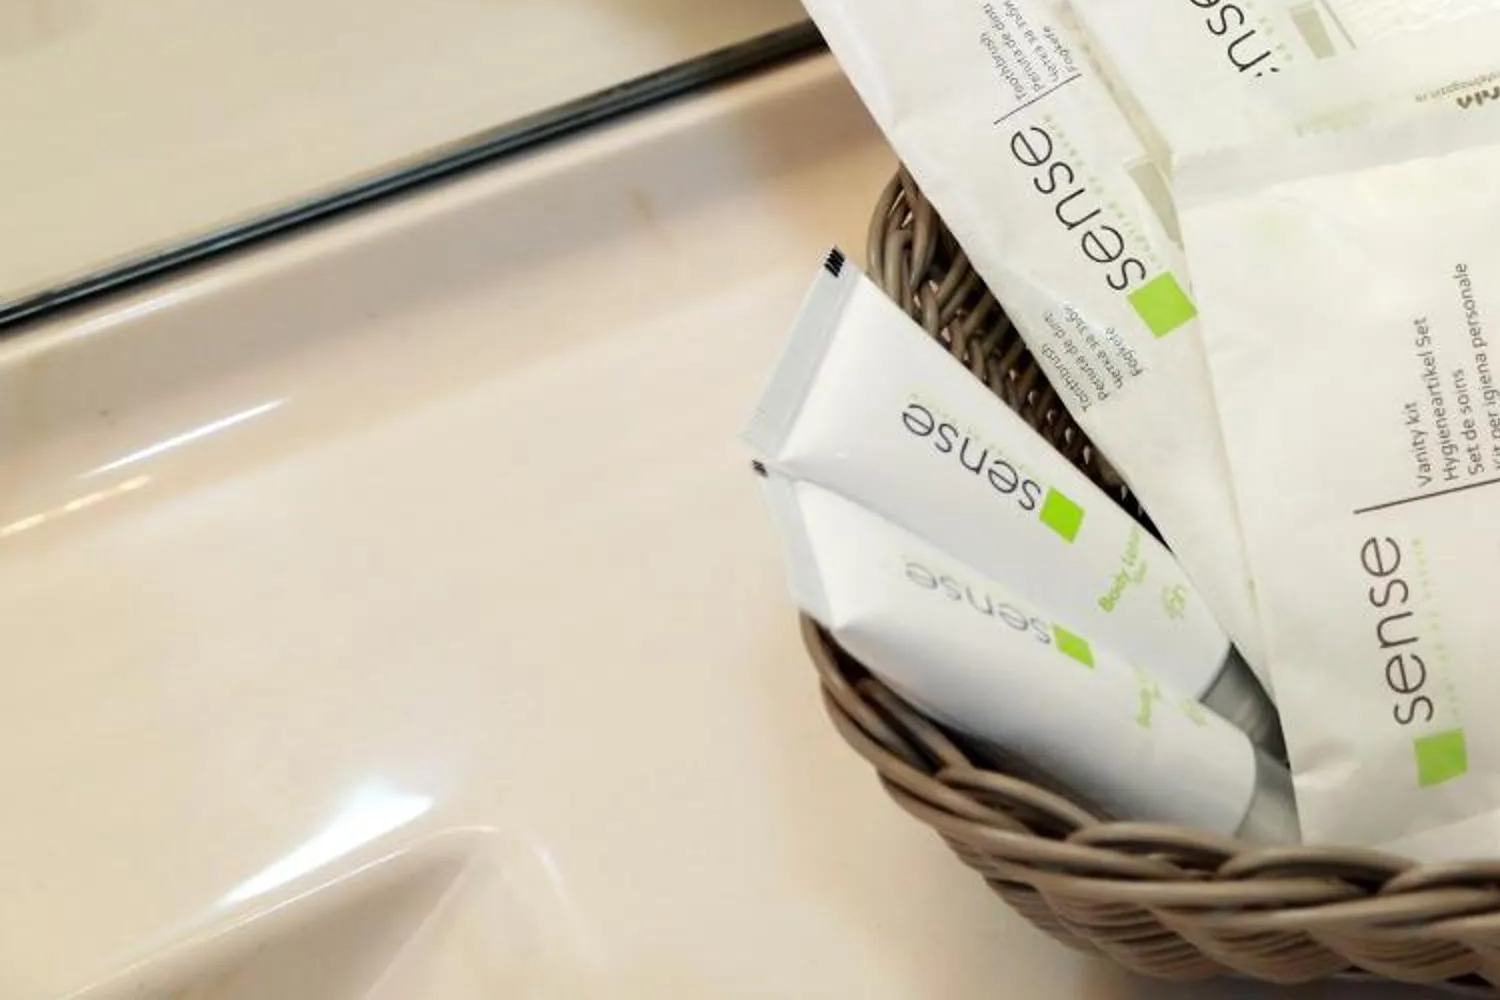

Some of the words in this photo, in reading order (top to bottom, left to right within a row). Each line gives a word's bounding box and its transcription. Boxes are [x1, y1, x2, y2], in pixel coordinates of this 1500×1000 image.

[980, 32, 1028, 101] Toothbrush
[1002, 32, 1017, 48] de
[1011, 127, 1146, 290] sense
[1414, 317, 1431, 347] Set
[1453, 263, 1488, 349] personale
[1063, 340, 1078, 355] de
[1453, 367, 1473, 414] soins
[1475, 352, 1500, 406] igiena
[1417, 351, 1459, 481] Hygieneartikel
[1461, 417, 1478, 440] de
[902, 403, 1042, 511] sense
[1411, 429, 1432, 488] Vanity
[1468, 448, 1485, 476] Set
[905, 561, 1051, 645] sense
[1361, 537, 1434, 725] sense
